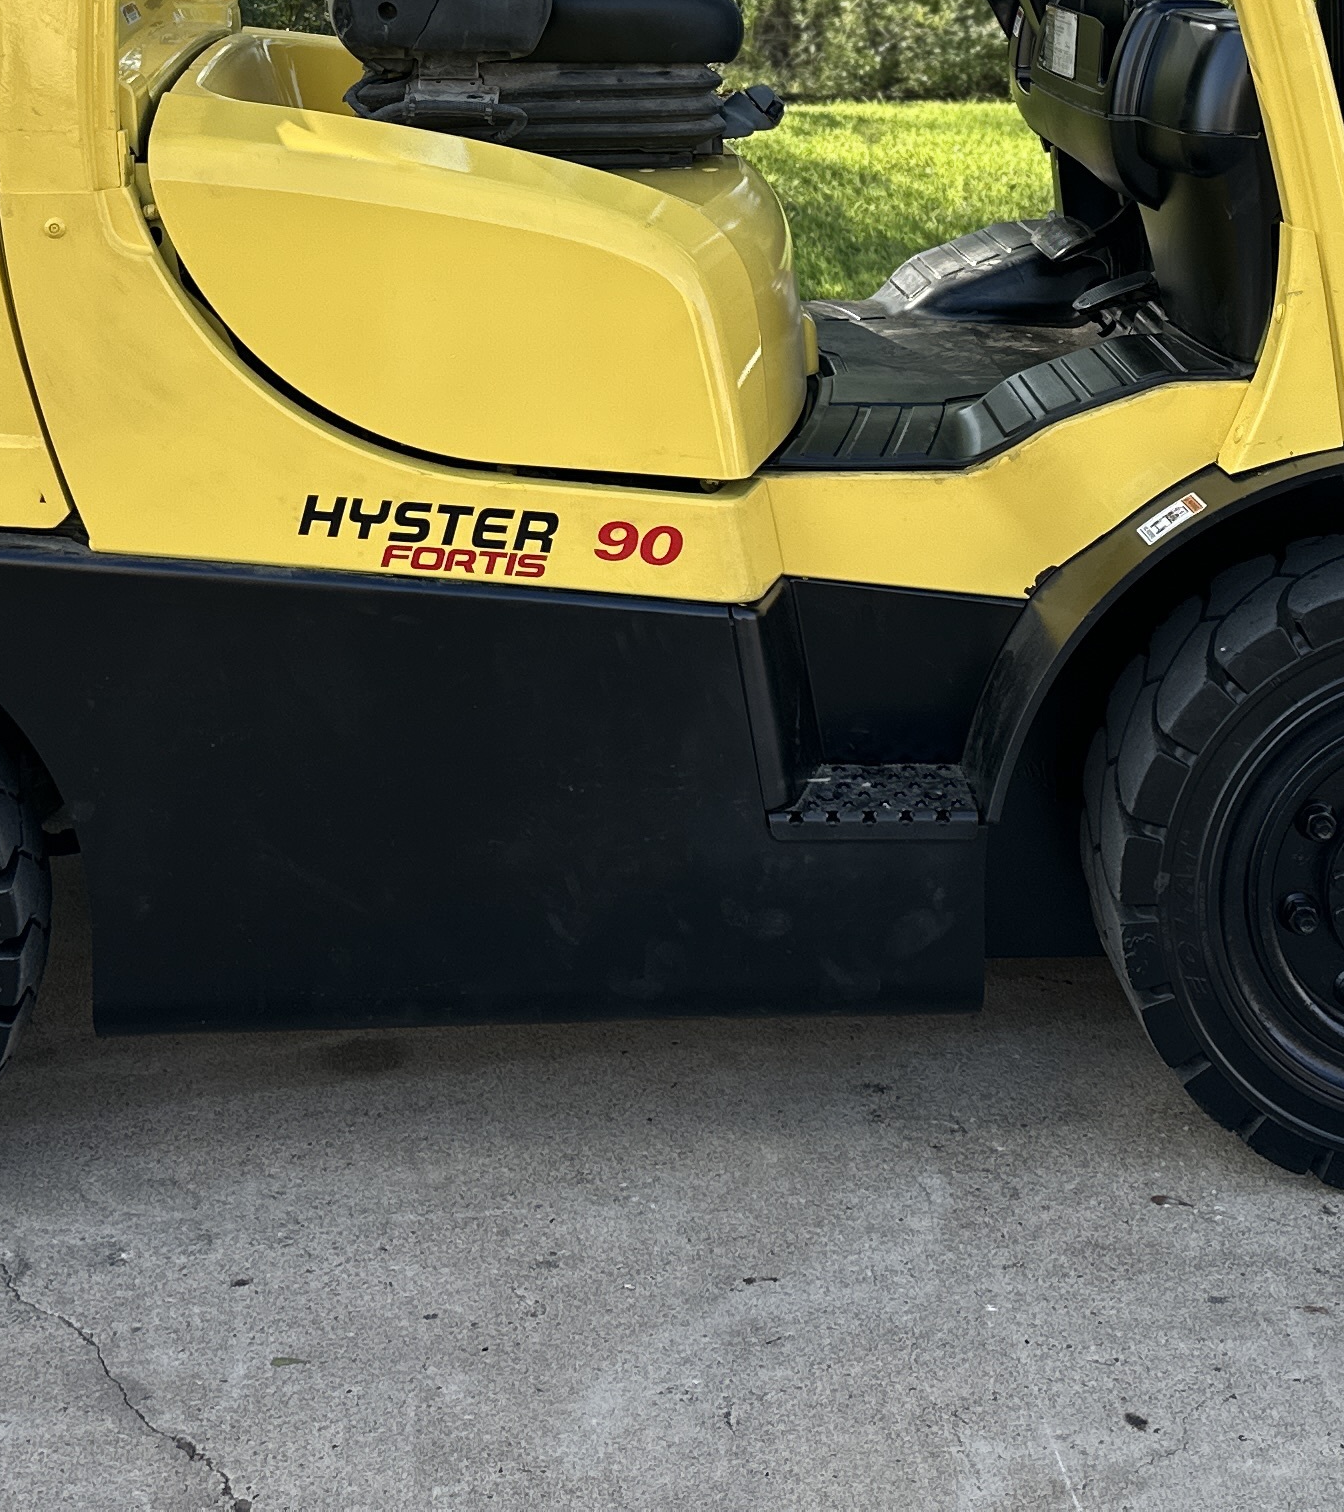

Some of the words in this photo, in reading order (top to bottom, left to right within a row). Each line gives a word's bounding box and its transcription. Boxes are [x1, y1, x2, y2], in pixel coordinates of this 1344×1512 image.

[297, 494, 560, 554] HYSTER
[593, 520, 685, 566] 90
[380, 544, 552, 579] FORTIS
